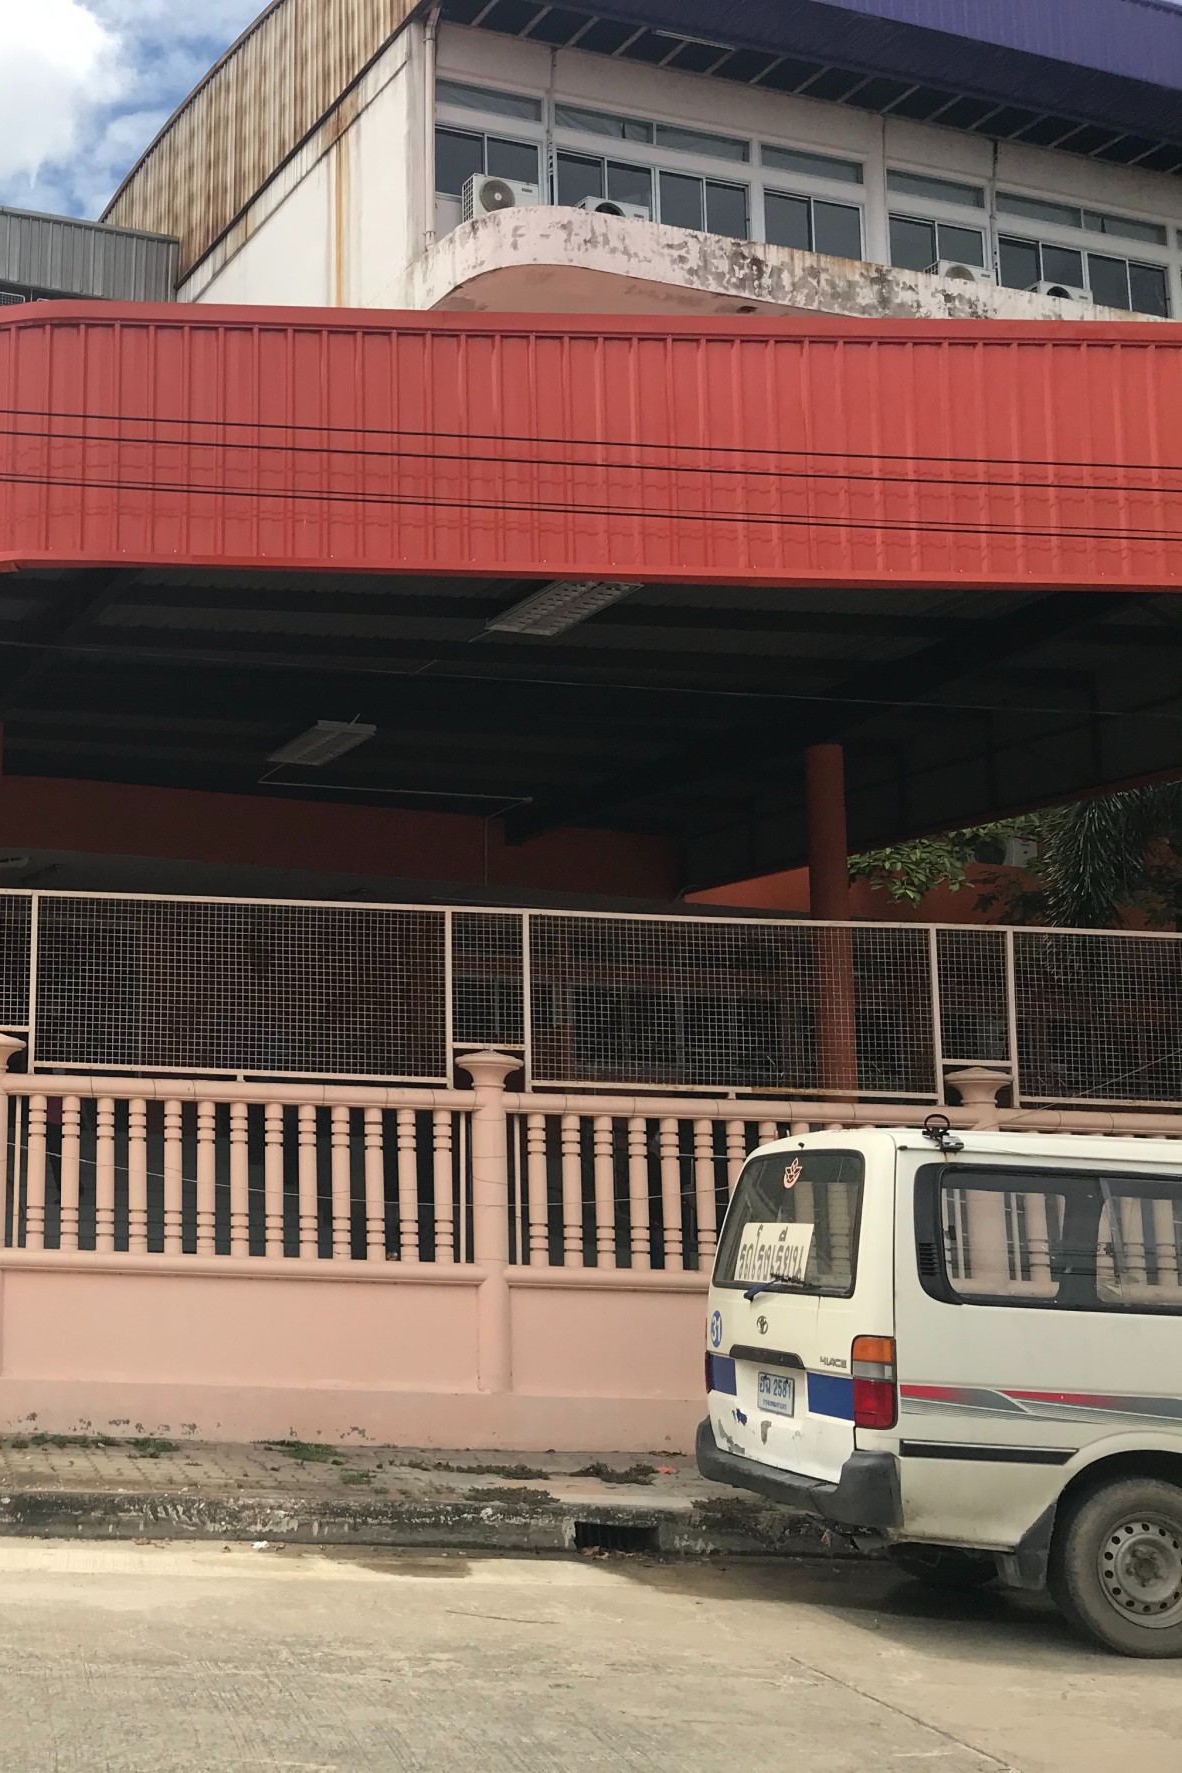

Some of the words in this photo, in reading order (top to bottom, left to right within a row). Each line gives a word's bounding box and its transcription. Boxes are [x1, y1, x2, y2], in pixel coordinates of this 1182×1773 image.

[710, 1315, 721, 1342] 31
[819, 1356, 847, 1369] HIACE
[773, 1378, 792, 1400] 2581
